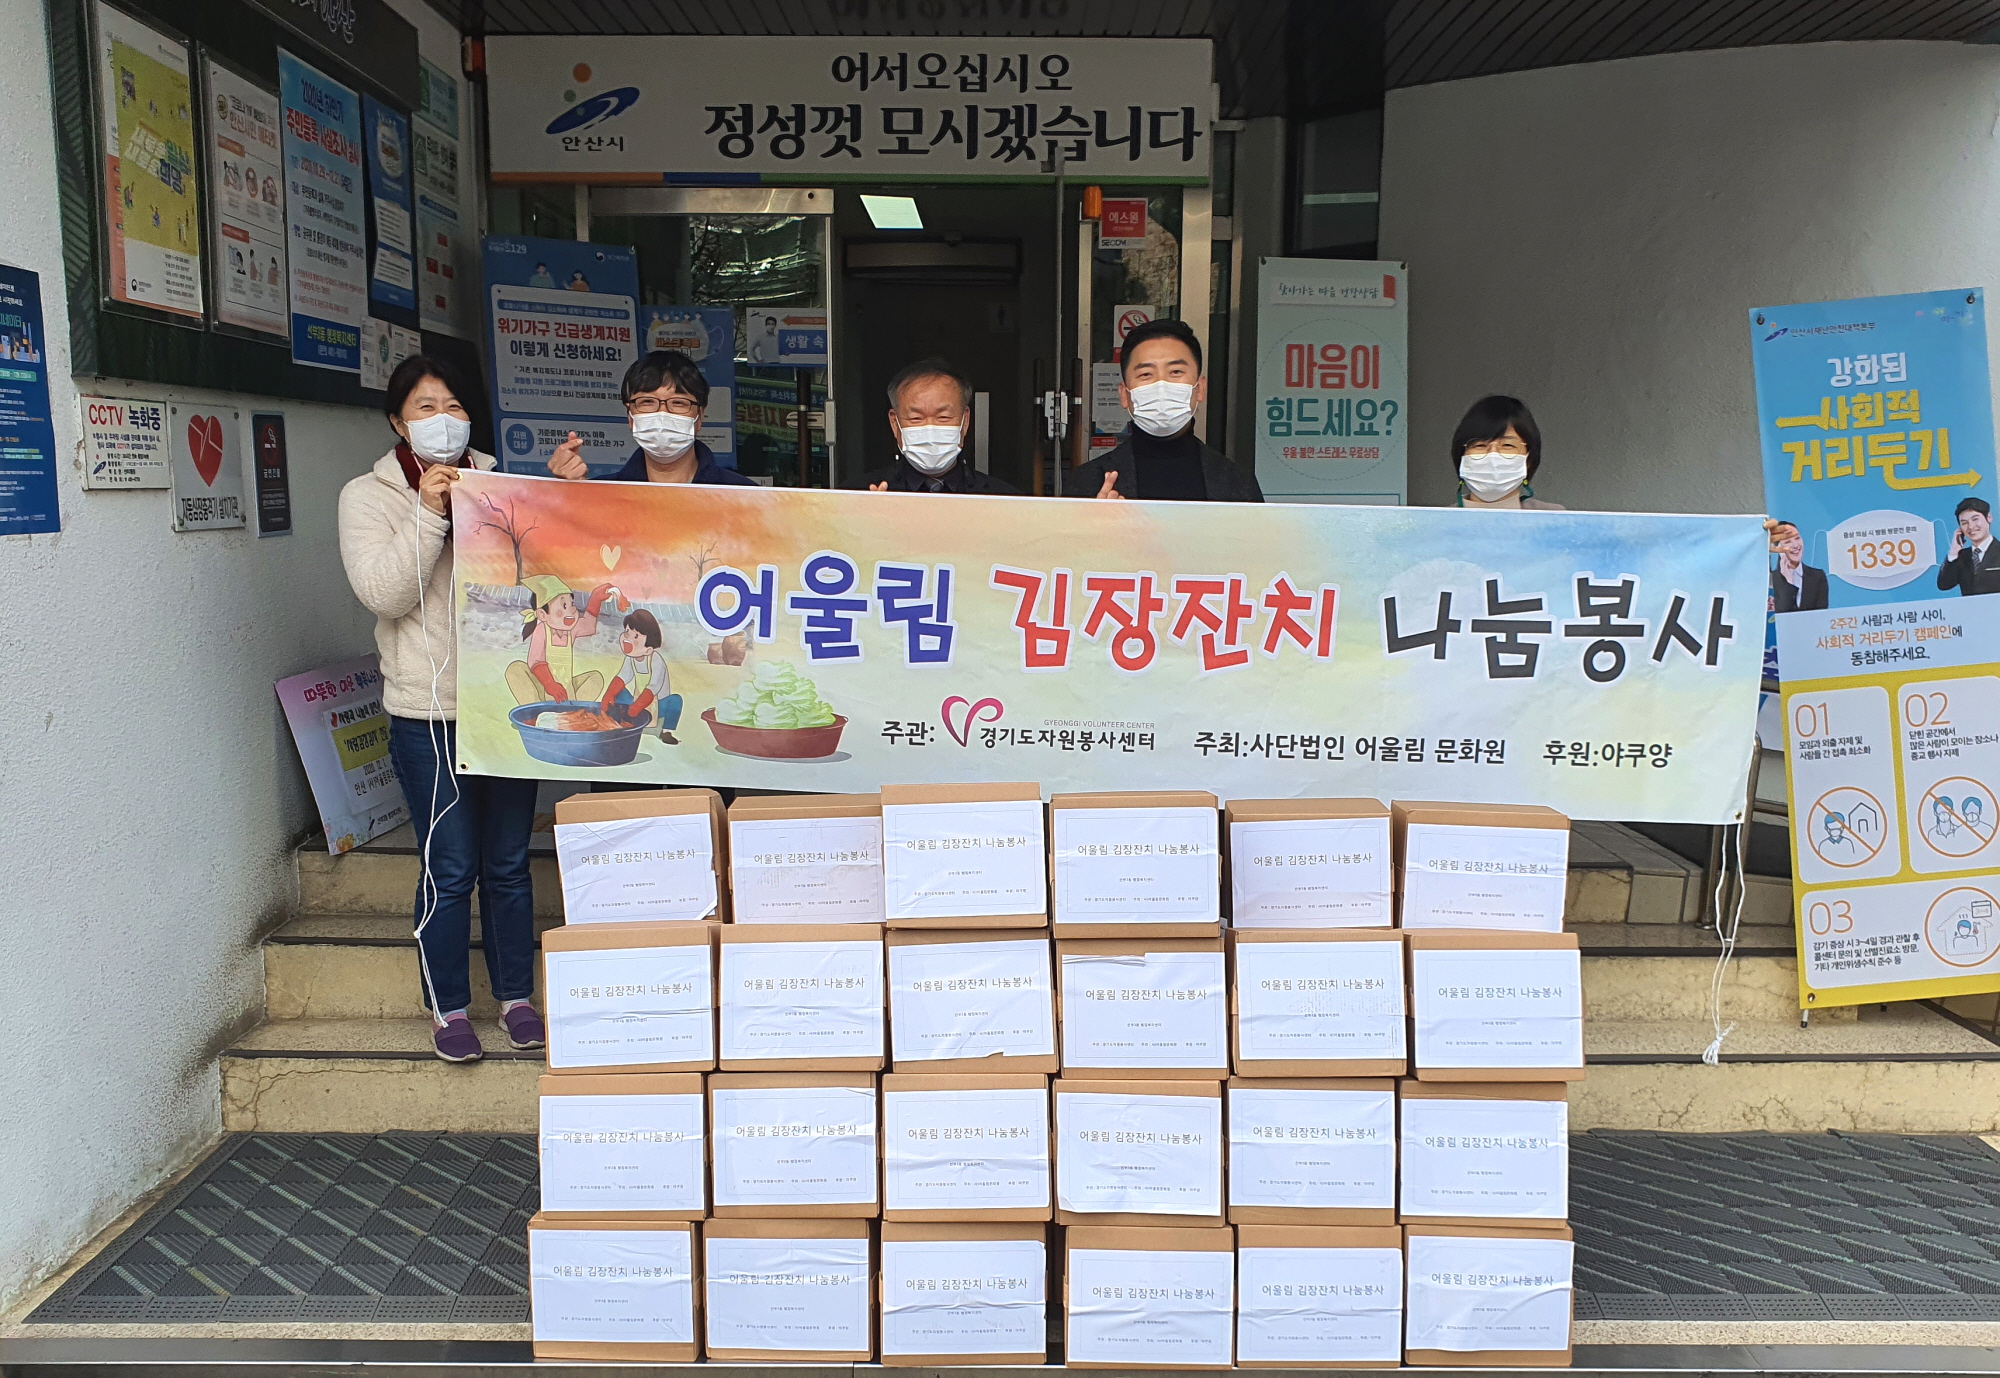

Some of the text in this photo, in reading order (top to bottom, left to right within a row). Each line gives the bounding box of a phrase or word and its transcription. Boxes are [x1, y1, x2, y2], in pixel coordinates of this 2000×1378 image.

[832, 52, 1073, 93] 어서오십시오
[286, 106, 319, 146] 주민등록
[704, 104, 1204, 161] 정성껏 모시겠습니다
[561, 136, 625, 152] 안산시
[160, 159, 183, 195] 희망
[1108, 211, 1139, 224] 에스원
[510, 244, 527, 254] 129
[1279, 282, 1314, 296] 찾아가는
[1318, 287, 1336, 297] 마음
[498, 317, 631, 343] 위기가구 긴급생계지원
[785, 334, 825, 349] 생활 속
[510, 340, 622, 362] 이렇게 신청하세요!
[1285, 343, 1379, 389] 마음이
[1827, 352, 1907, 388] 강화된
[88, 404, 161, 431] CCTV 녹화중
[1266, 397, 1399, 437] 힘드세요?
[1798, 389, 1921, 430] 사회적
[513, 430, 527, 439] 지원
[537, 428, 571, 438] 기준중위소
[513, 440, 528, 449] 대상
[1348, 446, 1380, 459] 무료상담
[1782, 429, 1950, 487] 거리두기
[1847, 539, 1916, 570] 1339
[698, 554, 1735, 683] 어울림 김장잔치 나눔봉사
[1830, 616, 1858, 630] 2주간
[1861, 613, 1893, 627] 사람과
[1896, 611, 1918, 625] 사람
[1816, 625, 1963, 650] 사회적 거리두기 캠페인에
[1850, 646, 1930, 667] 동참해주세요.
[304, 681, 337, 702] 따뜻한
[1905, 692, 1950, 727] 02
[1044, 718, 1155, 730] GYEONGGI VOLUNTEER CENTER
[1795, 702, 1829, 738] 01
[882, 720, 935, 747] 주관:
[979, 727, 1155, 751] 경기도자원봉사센터
[1926, 727, 1956, 738] 공간에서
[1194, 731, 1506, 766] 주최:사단법인 어울림 문화원
[1799, 740, 1820, 750] 모임과
[1855, 735, 1863, 744] 및
[1910, 734, 1999, 751] 많은 사람이 모이는 장소나
[1543, 739, 1673, 769] 후원:야쿠양
[1823, 750, 1831, 759] 간
[1848, 746, 1871, 756] 최소화
[1911, 751, 1925, 761] 종교
[354, 781, 367, 797] 안산
[906, 836, 1027, 851] 어울림 김장잔치 나눔봉사
[580, 848, 695, 866] 어울림 김장잔치 나눔봉사
[1428, 859, 1549, 875] 어울림 김장잔치 나눔봉사
[1809, 900, 1854, 935] 03
[1846, 938, 1854, 948] 시
[1879, 935, 1894, 945] 경과
[1895, 933, 1911, 943] 관찰
[1912, 932, 1920, 942] 후
[1814, 951, 1837, 962] 콜센터
[1838, 949, 1853, 960] 문의
[1854, 948, 1862, 958] 및
[1864, 945, 1901, 957] 선별진료소
[1814, 956, 1901, 972] 기타 개인위생수칙 준수 등
[743, 977, 865, 991] 어울림 김장잔치 나눔봉사
[1261, 978, 1384, 991] 어울림 김장잔치 나눔봉사
[1079, 1130, 1201, 1145] 어울림 김장잔치 나눔봉사
[553, 1265, 673, 1278] 어울림 김장잔치 나눔봉사
[1261, 1284, 1384, 1297] 어울림 김장잔치 나눔봉사
